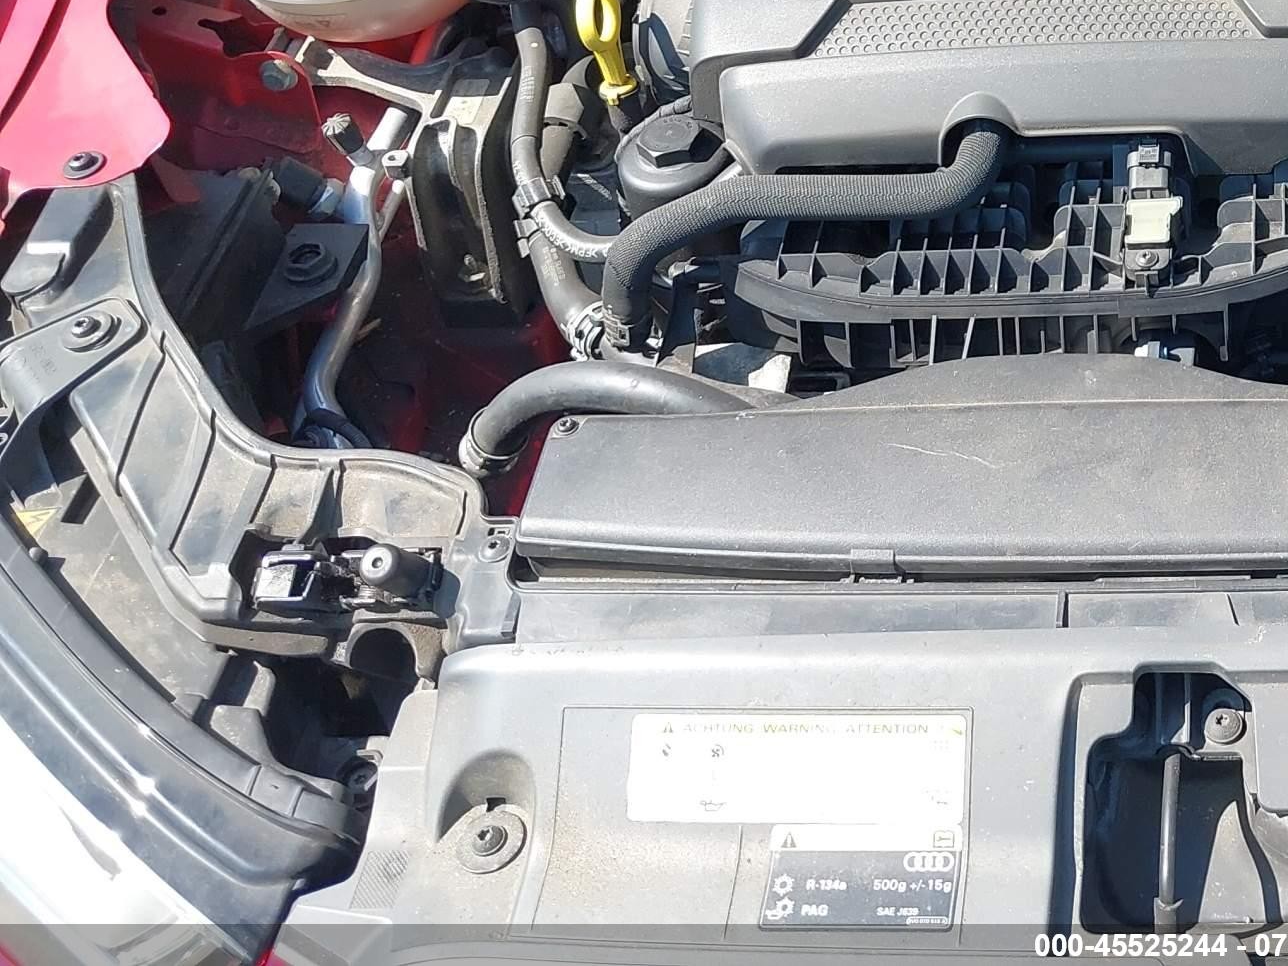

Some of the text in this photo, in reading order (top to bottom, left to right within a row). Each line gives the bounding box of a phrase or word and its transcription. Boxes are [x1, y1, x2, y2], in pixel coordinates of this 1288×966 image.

[805, 878, 848, 891] R-134a
[873, 878, 907, 893] 500g
[927, 878, 953, 894] 15g
[800, 903, 829, 917] PAG
[876, 906, 896, 917] SAE
